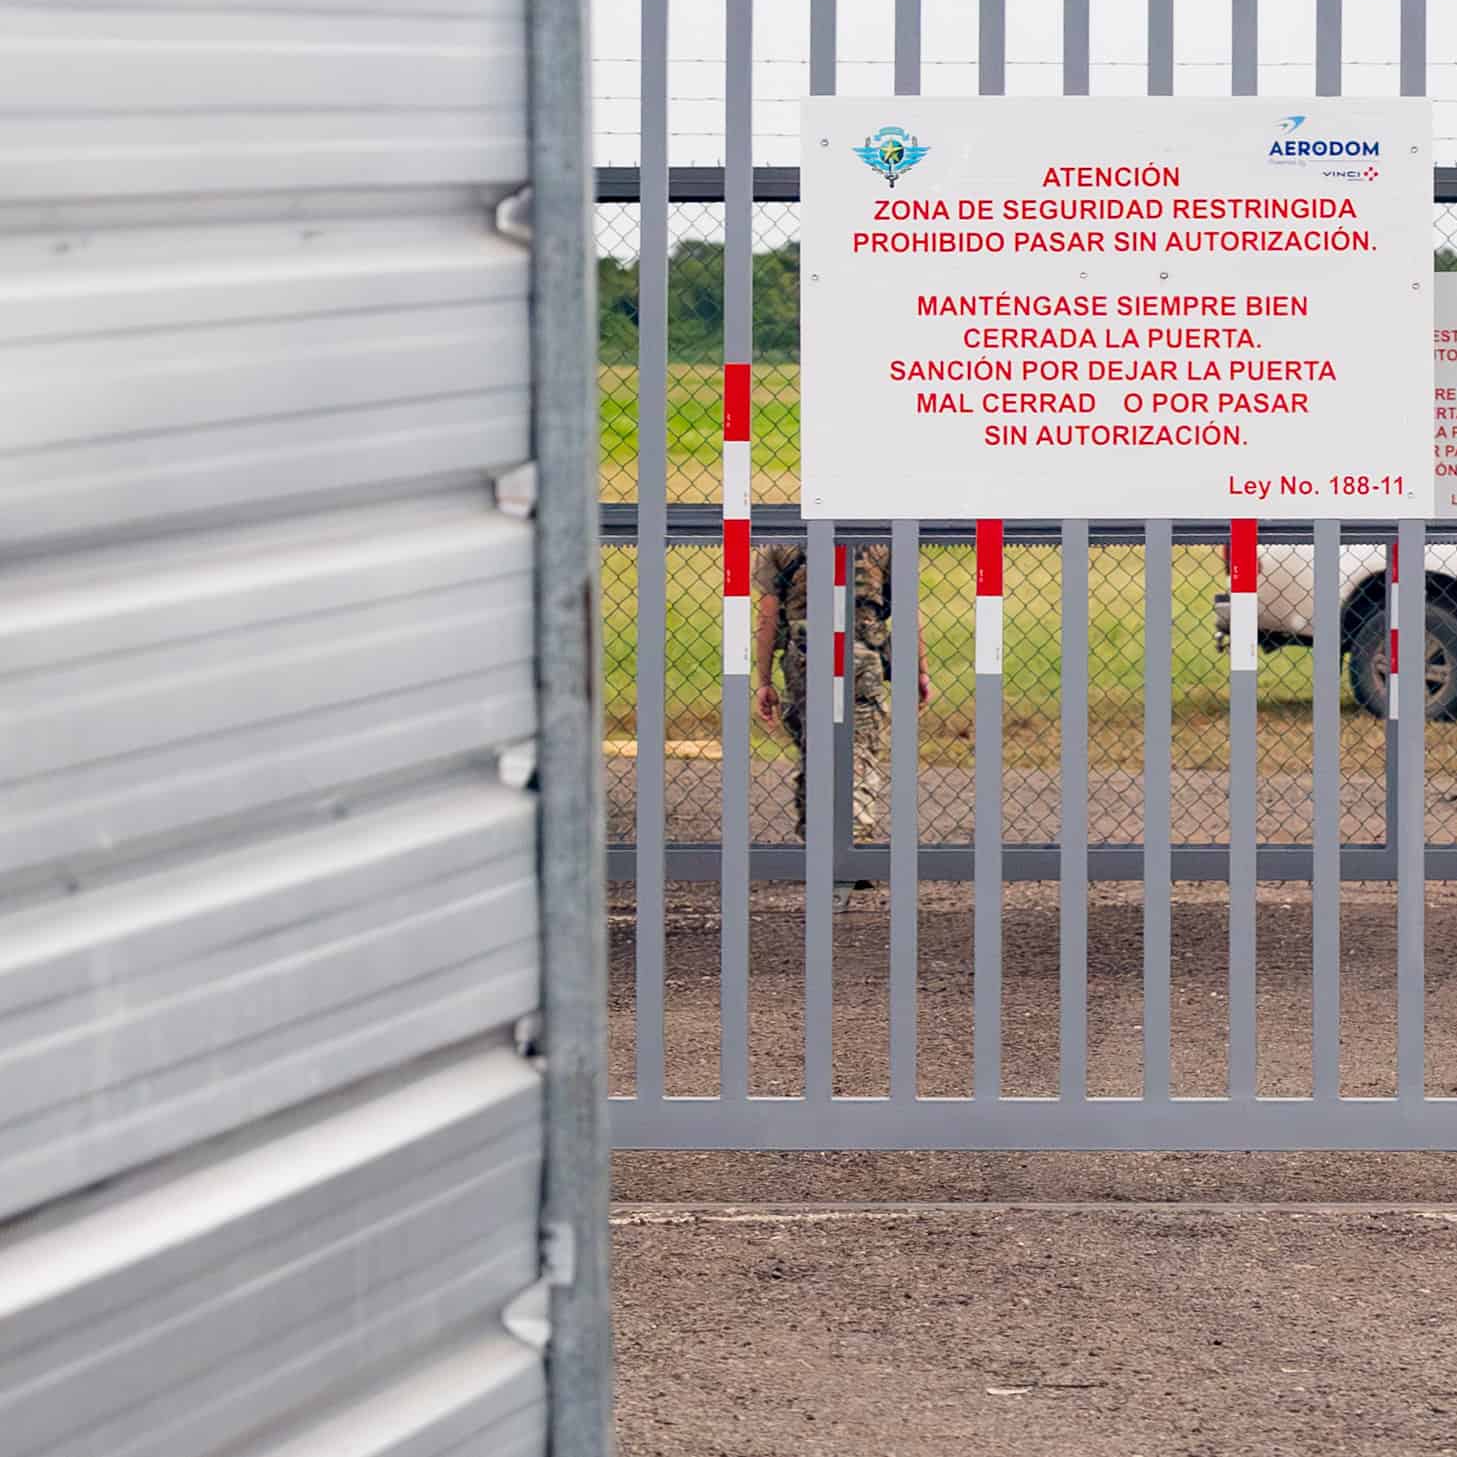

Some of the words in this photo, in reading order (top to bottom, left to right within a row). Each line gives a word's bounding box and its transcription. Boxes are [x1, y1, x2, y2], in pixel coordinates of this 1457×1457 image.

[1269, 140, 1380, 157] AERODOM
[1042, 161, 1180, 187] ATENCIÓN
[1322, 170, 1361, 178] VINCI
[873, 199, 950, 222] ZONA
[957, 199, 994, 221] DE
[1002, 198, 1164, 221] SEGURIDAD
[1172, 197, 1358, 221] RESTRINGIDA
[852, 231, 1006, 254] PROHIBIDO
[1013, 231, 1105, 253] PASAR
[1113, 231, 1158, 253] SIN
[1164, 226, 1377, 253] AUTORIZACIÓN.
[917, 289, 1108, 317] MANTÉNGASE
[1116, 295, 1237, 317] SIEMPRE
[1245, 295, 1308, 317] BIEN
[963, 327, 1098, 350] CERRADA
[1105, 327, 1140, 349] LA
[1147, 327, 1262, 349] PUERTA.
[889, 356, 1013, 382] SANCIÓN
[1021, 359, 1079, 382] POR
[1087, 359, 1179, 382] DEJAR
[1186, 359, 1222, 382] LA
[1229, 359, 1337, 382] PUERTA
[916, 392, 974, 414] MAL
[981, 392, 1097, 414] CERRAD
[1123, 392, 1144, 414] O
[1151, 392, 1209, 414] POR
[1217, 392, 1309, 415] PASAR
[983, 424, 1028, 447] SIN
[1035, 420, 1248, 447] AUTORIZACIÓN.
[1228, 475, 1272, 500] Ley
[1280, 475, 1320, 496] No.
